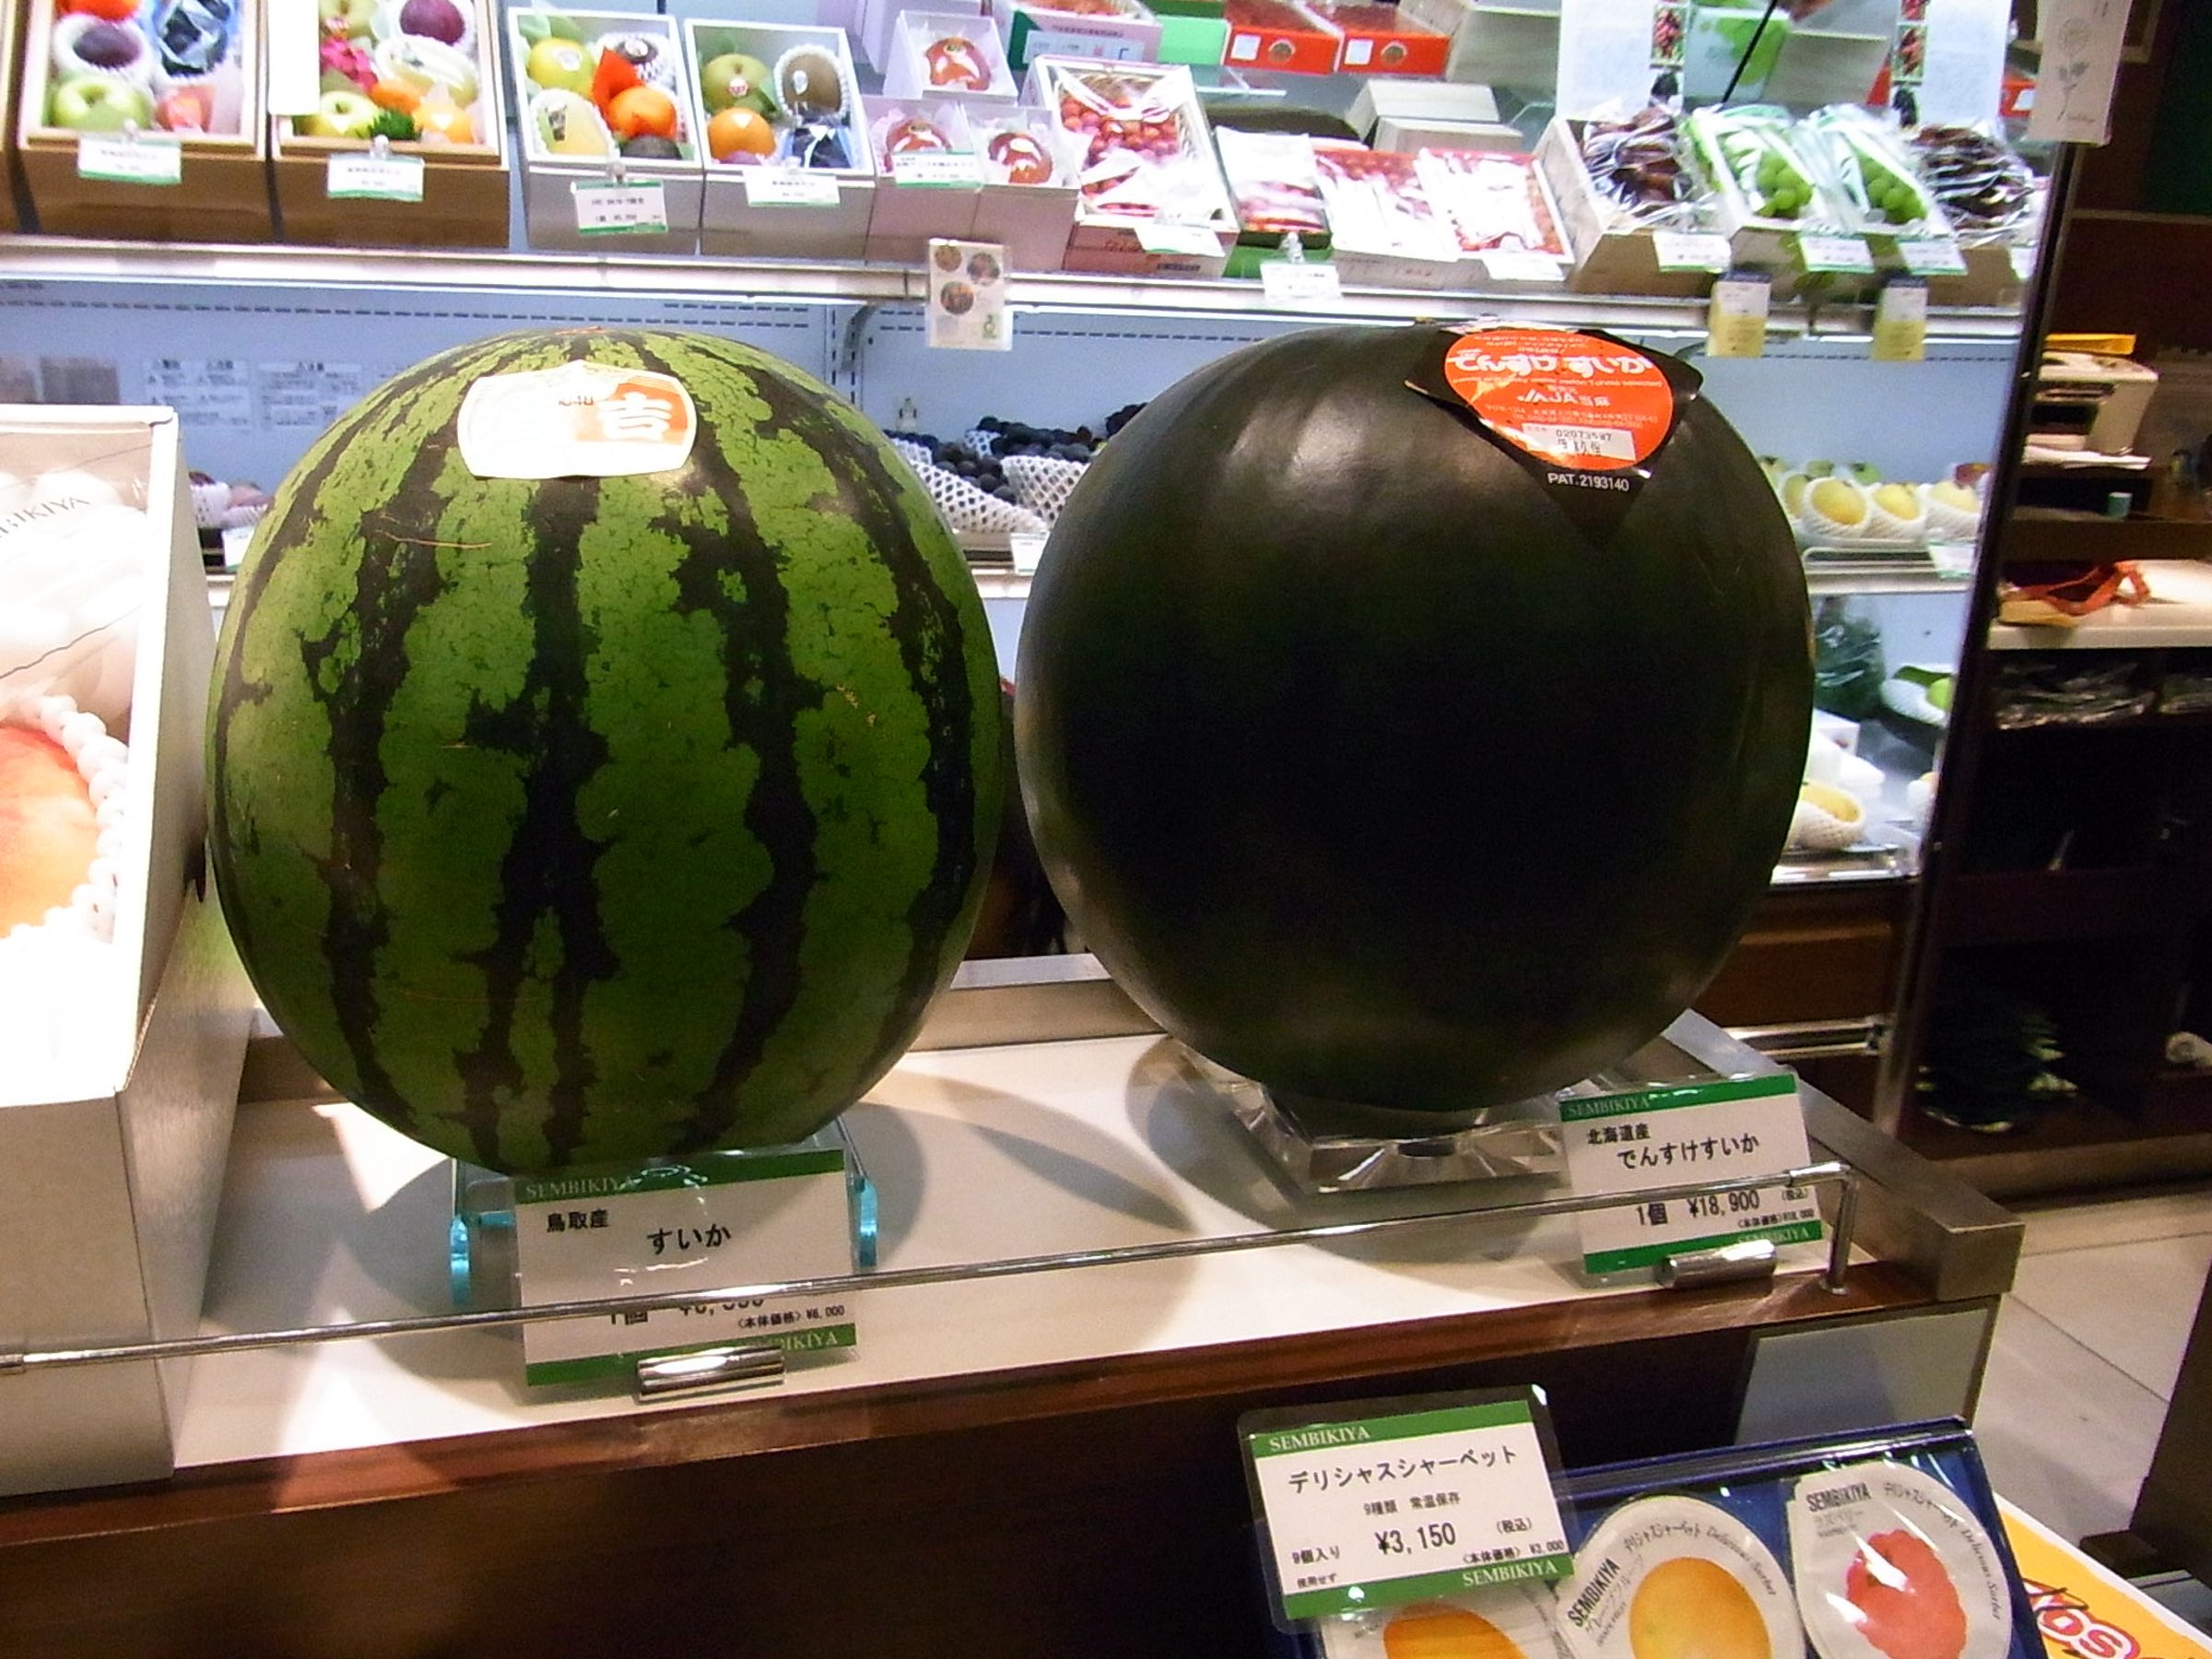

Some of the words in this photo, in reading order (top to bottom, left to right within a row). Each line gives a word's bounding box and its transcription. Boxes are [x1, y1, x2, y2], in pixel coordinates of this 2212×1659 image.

[1587, 1123, 1651, 1145] 北海道産
[1617, 1132, 1759, 1170] でんすけすいか
[547, 1208, 609, 1232] 鳥取産
[1636, 1202, 1668, 1226] 1個
[1687, 1189, 1760, 1218] ¥18,900
[647, 1222, 733, 1255] すいか
[1269, 1426, 1371, 1453] SEMBIKIYA
[1288, 1444, 1517, 1494] デリシャスシャーベット
[1373, 1522, 1456, 1556] ¥3,150
[1462, 1559, 1559, 1588] SEMBIKIYA
[1567, 1557, 1621, 1628] SEMBIKIYA
